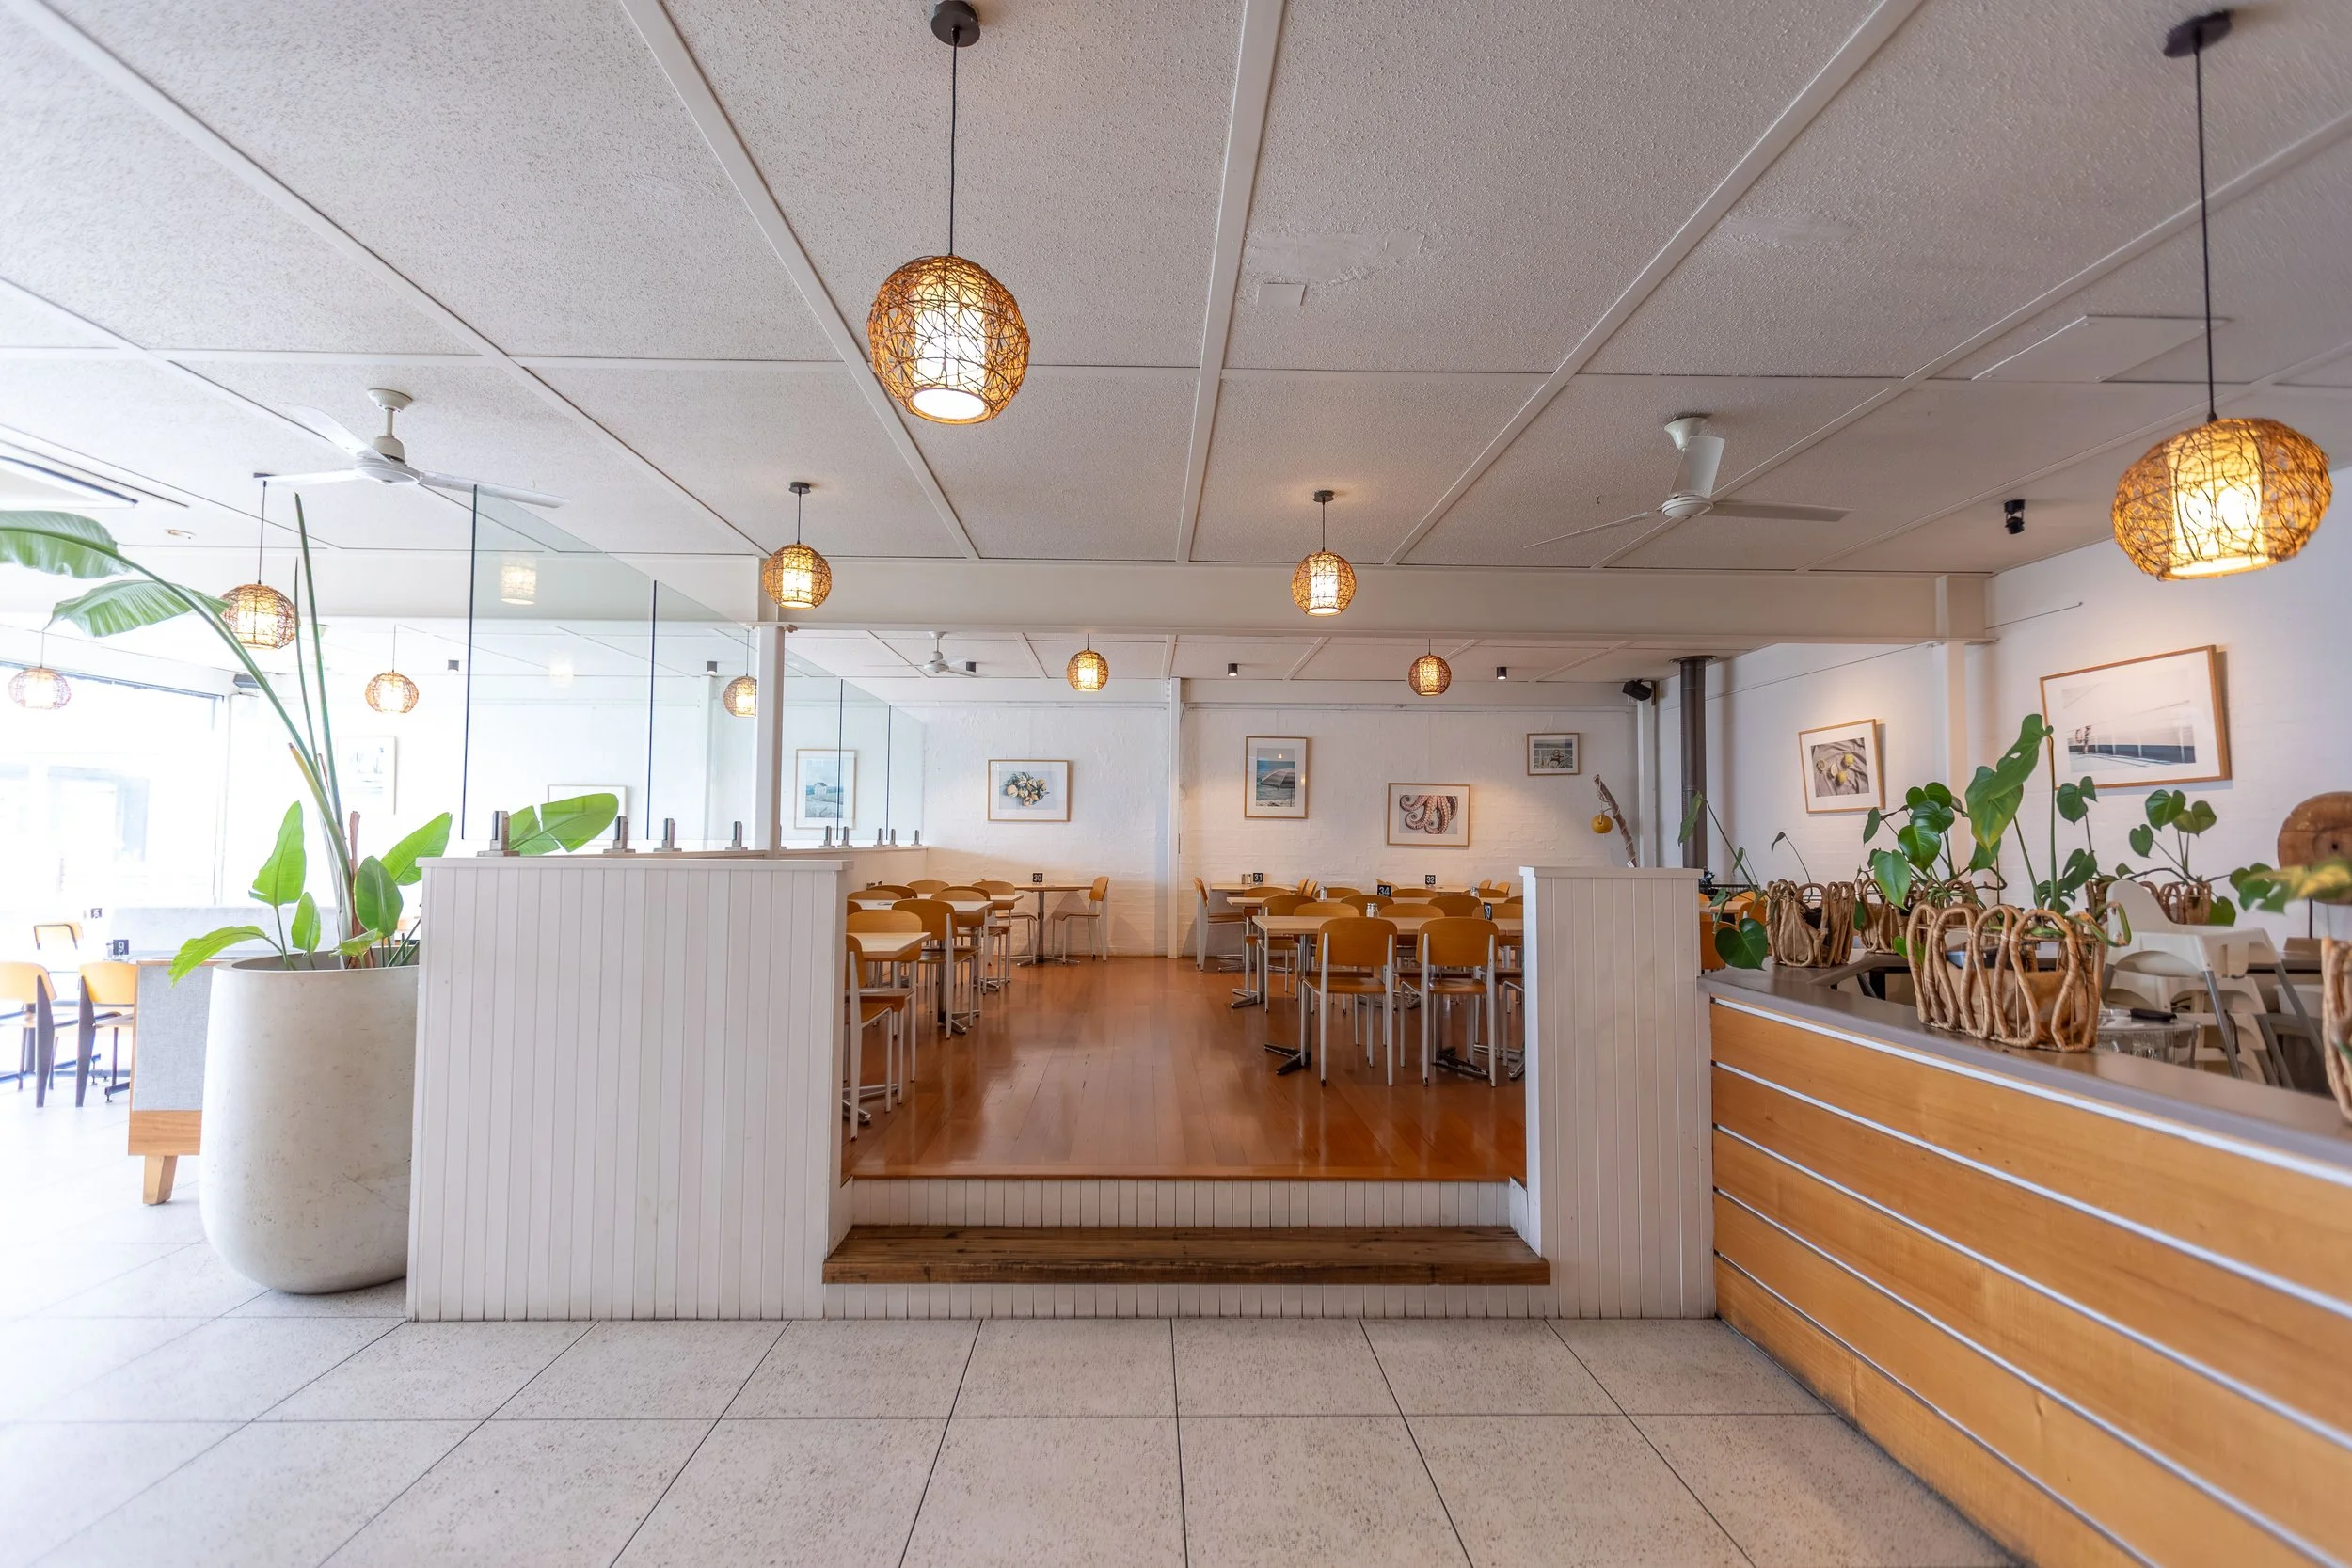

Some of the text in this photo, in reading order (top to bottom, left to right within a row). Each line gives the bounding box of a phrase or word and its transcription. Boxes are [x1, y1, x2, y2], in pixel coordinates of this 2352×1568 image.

[1033, 874, 1042, 882] 30
[1254, 873, 1263, 881] 31
[1426, 876, 1435, 884] 32
[1378, 886, 1391, 896] 34
[118, 942, 125, 953] 9
